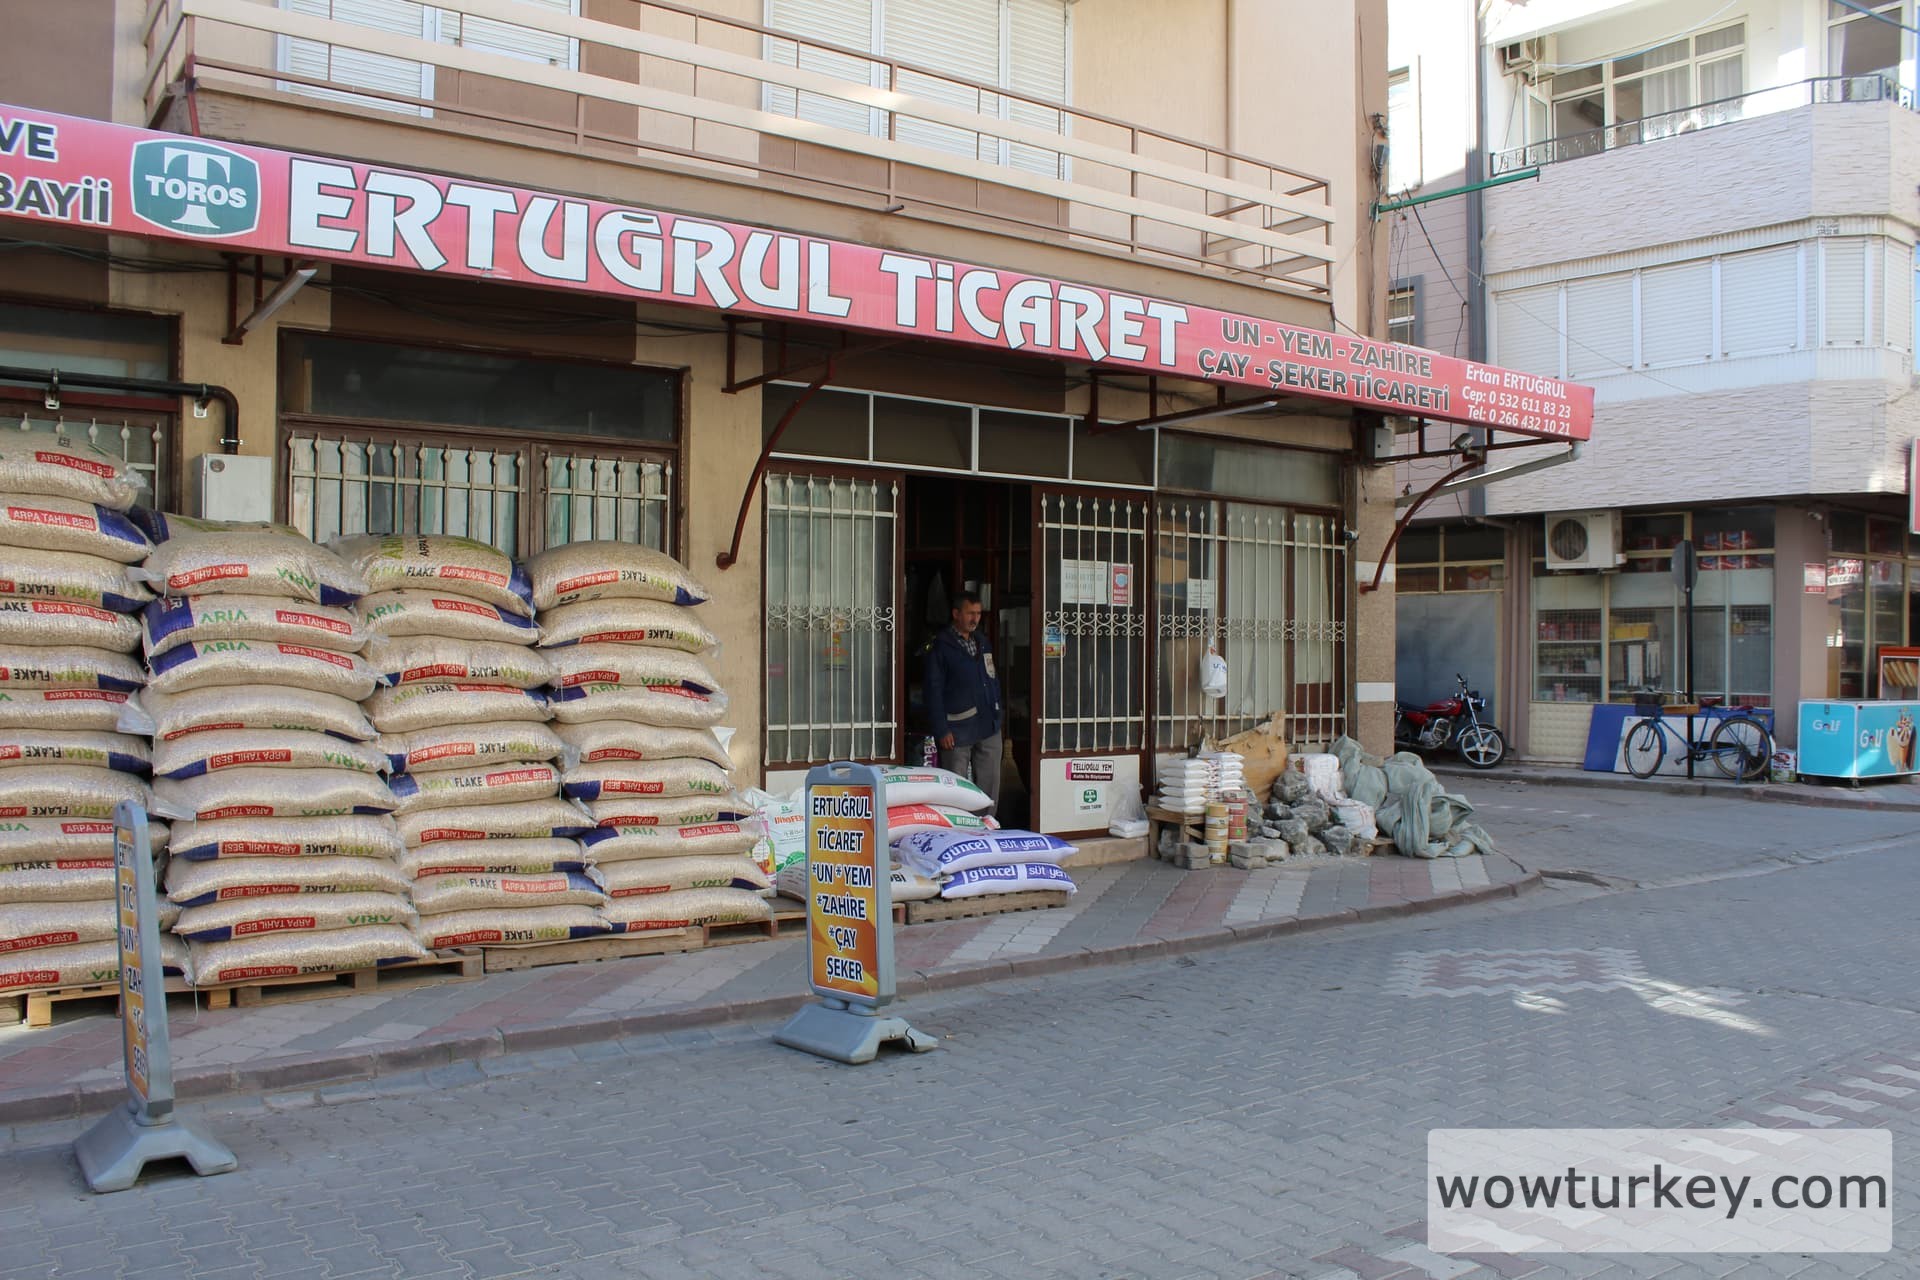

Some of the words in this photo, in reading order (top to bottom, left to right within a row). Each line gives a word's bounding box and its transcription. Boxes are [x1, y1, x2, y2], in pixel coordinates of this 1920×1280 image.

[0, 120, 57, 161] VE
[145, 176, 247, 208] TOROS
[1222, 318, 1260, 346] UN
[1278, 329, 1332, 360] YEM
[1349, 342, 1432, 379] ZAHİRE
[1198, 349, 1250, 379] ÇAY
[1269, 360, 1346, 395] ŞEKER
[1351, 370, 1450, 412] TİCARETİ
[1466, 364, 1499, 385] Ertan
[1502, 372, 1567, 399] ERTUĞRUL
[1462, 385, 1486, 405] Cep:
[1488, 392, 1497, 405] 0
[1498, 395, 1518, 409] 532
[1521, 399, 1540, 413] 611
[1543, 402, 1556, 416] 83
[1559, 404, 1571, 419] 23
[1468, 404, 1486, 421] Tel:
[1488, 409, 1496, 423] 0
[1498, 411, 1518, 426] 266
[1521, 414, 1540, 430] 432
[1543, 418, 1556, 433] 10
[1558, 421, 1570, 436] 21
[13, 511, 40, 521] ARPA
[406, 566, 436, 577] FLAKE
[621, 570, 646, 582] FLAKE
[20, 583, 56, 595] FLAKE
[280, 613, 304, 625] ARPA
[648, 629, 673, 639] FLAKE
[14, 668, 50, 681] FLAKE
[471, 667, 498, 677] FLAKE
[426, 684, 453, 694] FLAKE
[25, 746, 61, 758] FLAKE
[479, 743, 506, 753] FLAKE
[235, 752, 262, 762] TAHIL
[262, 750, 287, 761] ARPA
[455, 778, 482, 787] FLAKE
[489, 775, 510, 784] ARPA
[511, 772, 532, 782] TAHIL
[622, 782, 642, 791] TAHIL
[642, 783, 661, 792] ARPA
[32, 806, 68, 816] FLAKE
[812, 793, 872, 818] ERTUĞRUL
[94, 824, 113, 833] TAH
[682, 828, 701, 837] ARPA
[817, 825, 864, 852] TİCARET
[274, 844, 297, 854] ARPA
[305, 844, 337, 854] FLAKE
[942, 839, 988, 862] güncel
[1000, 838, 1017, 849] süt
[1021, 837, 1045, 850] yemi
[969, 866, 1016, 881] güncel
[1029, 864, 1046, 876] süt
[469, 878, 497, 889] FLAKE
[504, 882, 525, 891] ARPA
[259, 920, 285, 932] TAHIL
[286, 918, 312, 929] ARPA
[504, 930, 533, 940] FLAKE
[826, 956, 863, 982] ŞEKER
